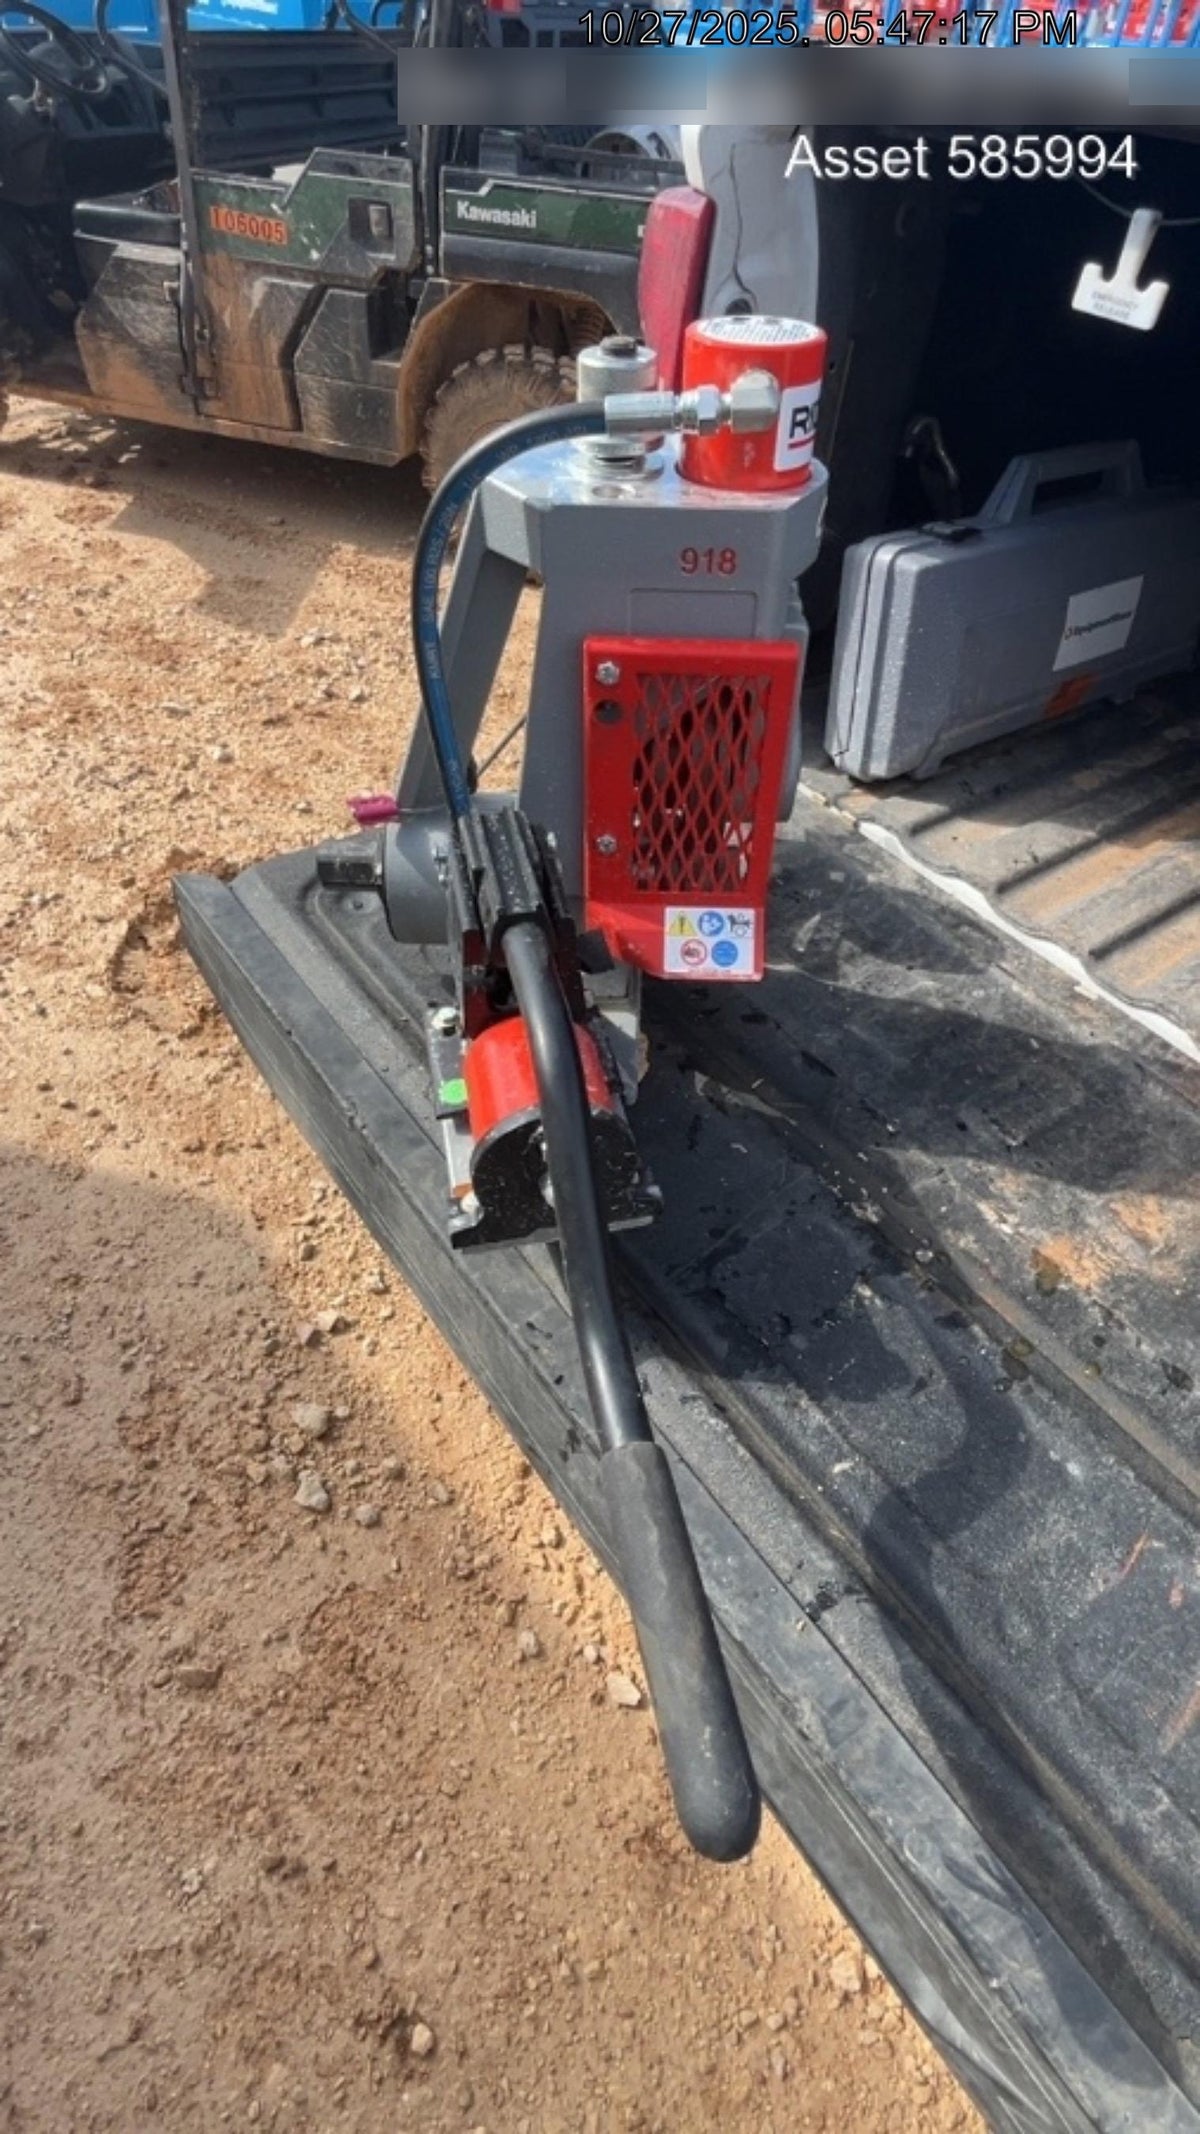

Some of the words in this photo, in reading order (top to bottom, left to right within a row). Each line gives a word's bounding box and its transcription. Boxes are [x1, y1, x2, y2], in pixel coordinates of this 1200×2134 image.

[211, 206, 286, 244] 106005
[456, 200, 537, 229] Kawasaki
[680, 547, 737, 574] 918
